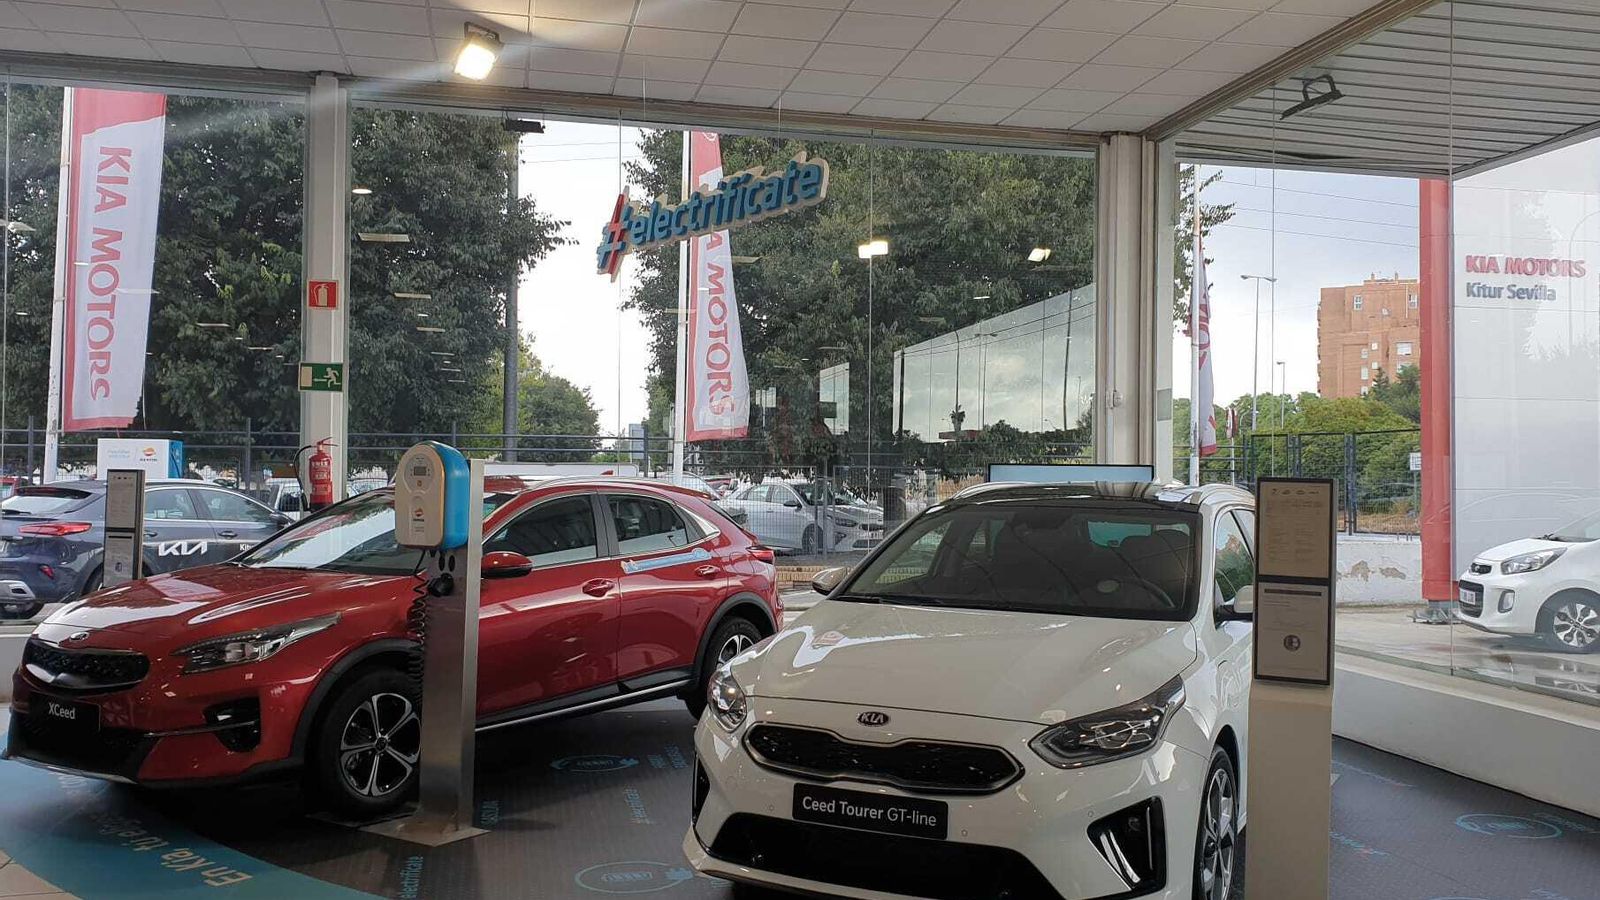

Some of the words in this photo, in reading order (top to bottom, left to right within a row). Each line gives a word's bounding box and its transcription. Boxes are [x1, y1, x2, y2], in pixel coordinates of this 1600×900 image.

[94, 146, 132, 214] KIA
[1465, 255, 1499, 273] KIA
[1504, 257, 1586, 278] MOTORS
[1466, 282, 1505, 299] Kitur
[1507, 284, 1557, 301] Sevilla
[705, 262, 735, 416] MOTORS
[48, 702, 76, 720] XCeed
[860, 712, 885, 724] KIA
[802, 796, 836, 813] Ceed
[839, 801, 884, 820] Tourer
[887, 807, 937, 827] GT-line
[200, 866, 254, 887] En
